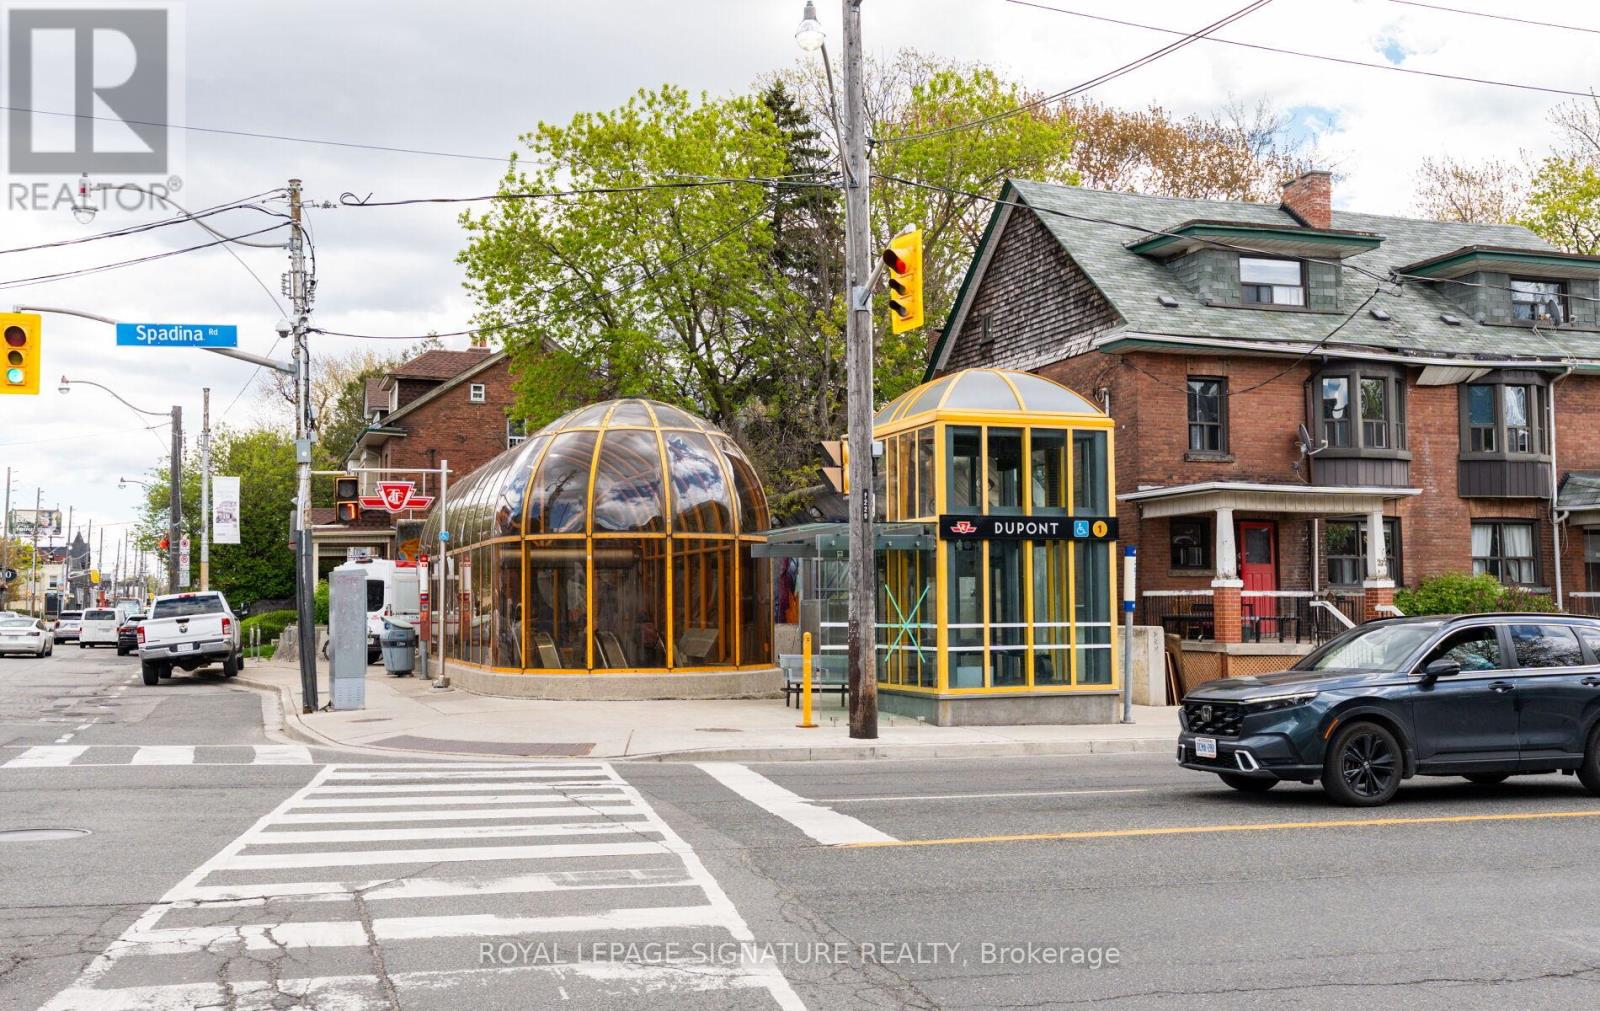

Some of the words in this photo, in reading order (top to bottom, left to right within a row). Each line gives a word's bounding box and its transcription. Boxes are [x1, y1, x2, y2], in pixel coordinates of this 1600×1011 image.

[136, 325, 204, 344] Spadina
[208, 328, 218, 336] Rd
[994, 522, 1059, 535] DUPONT
